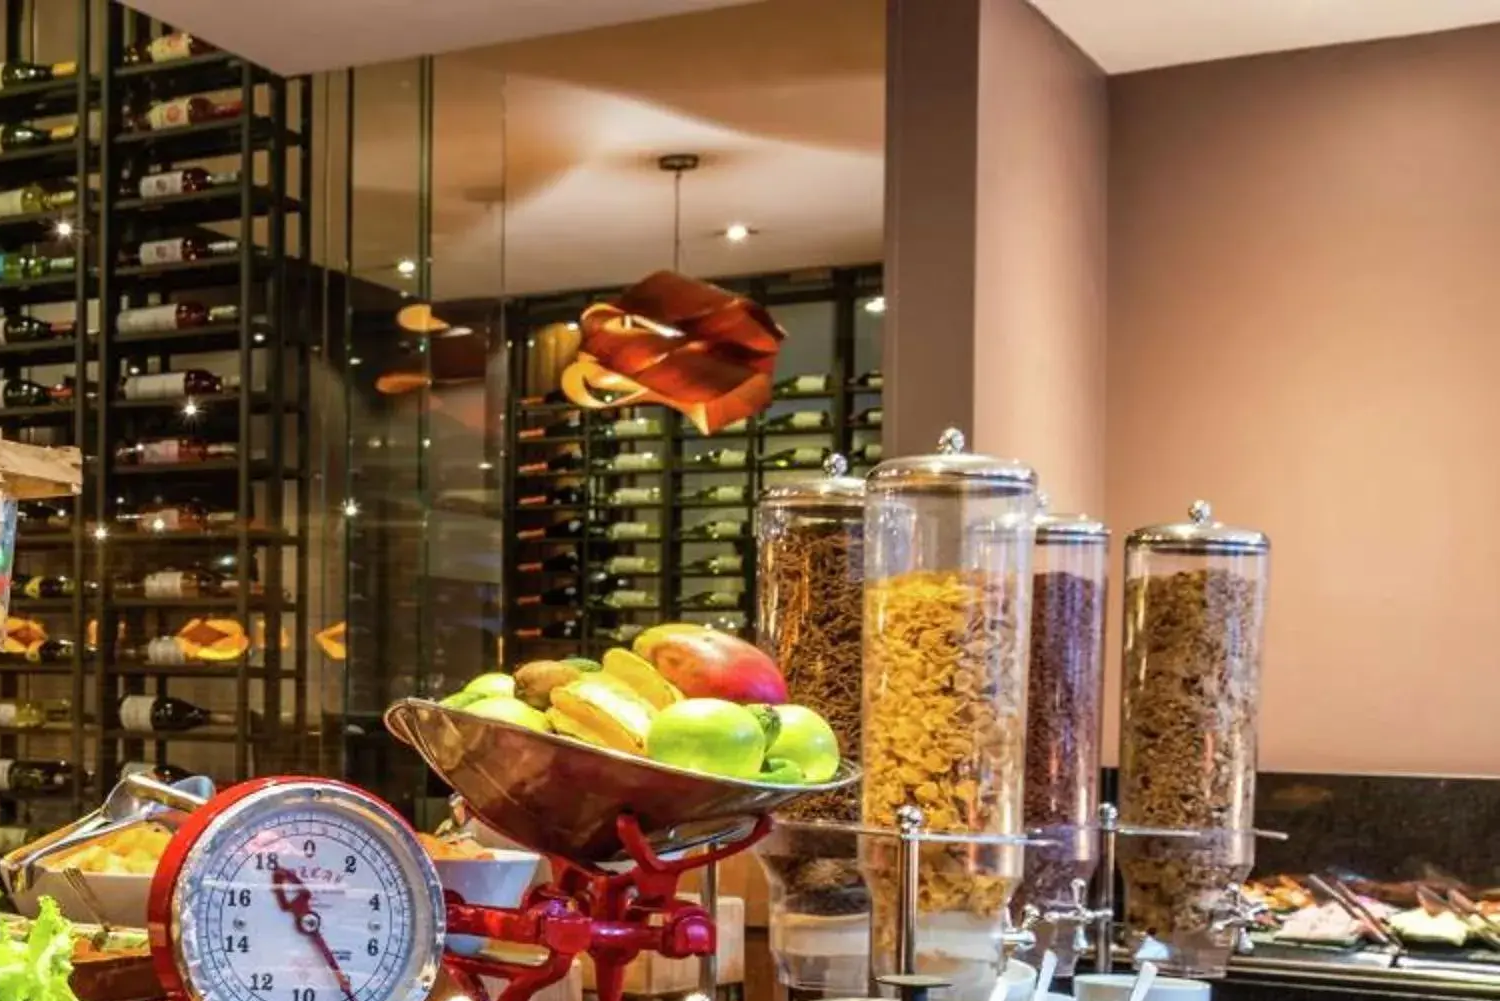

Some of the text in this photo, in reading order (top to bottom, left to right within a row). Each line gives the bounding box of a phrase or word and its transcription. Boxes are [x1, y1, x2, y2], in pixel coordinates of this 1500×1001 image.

[303, 839, 316, 858] 0
[255, 852, 278, 870] 18
[345, 855, 356, 873] 2
[228, 888, 251, 907] 16
[368, 893, 380, 911] 4
[225, 935, 249, 953] 14
[367, 937, 379, 956] 6
[250, 973, 273, 991] 12
